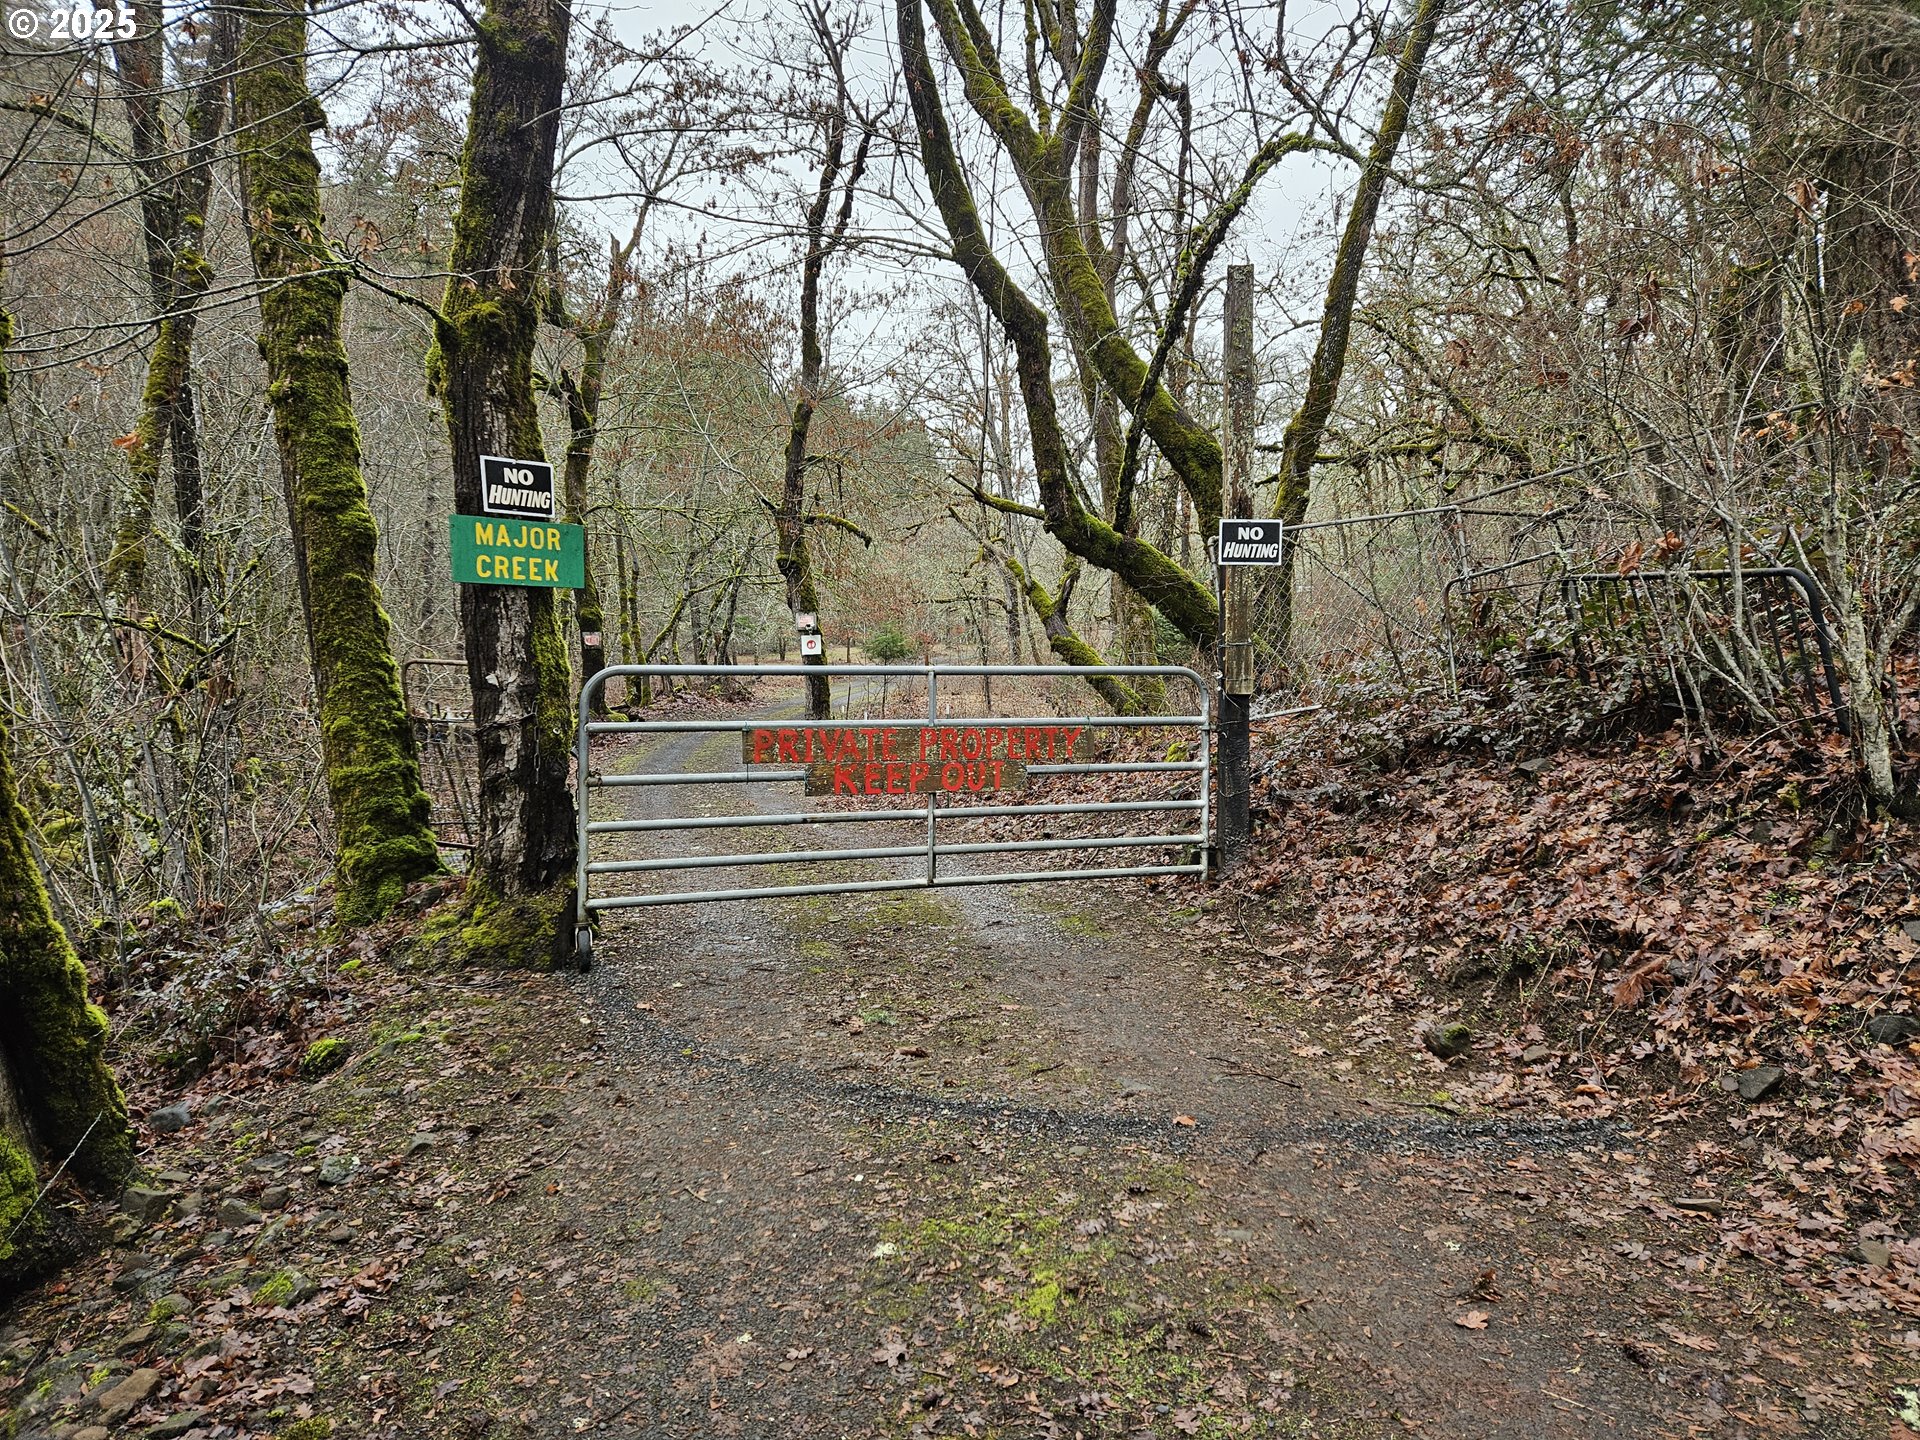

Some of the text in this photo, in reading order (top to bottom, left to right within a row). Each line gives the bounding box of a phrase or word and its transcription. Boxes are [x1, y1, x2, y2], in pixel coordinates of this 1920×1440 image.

[503, 467, 534, 486] NO
[488, 484, 551, 509] HUNTING
[475, 522, 561, 551] MAJOR
[1237, 526, 1264, 541] NO
[1222, 541, 1279, 559] HUNTING
[476, 555, 559, 582] CREEK
[753, 727, 1083, 764] PRIVATE PROPERTY
[834, 761, 1005, 796] KEEP OUT
